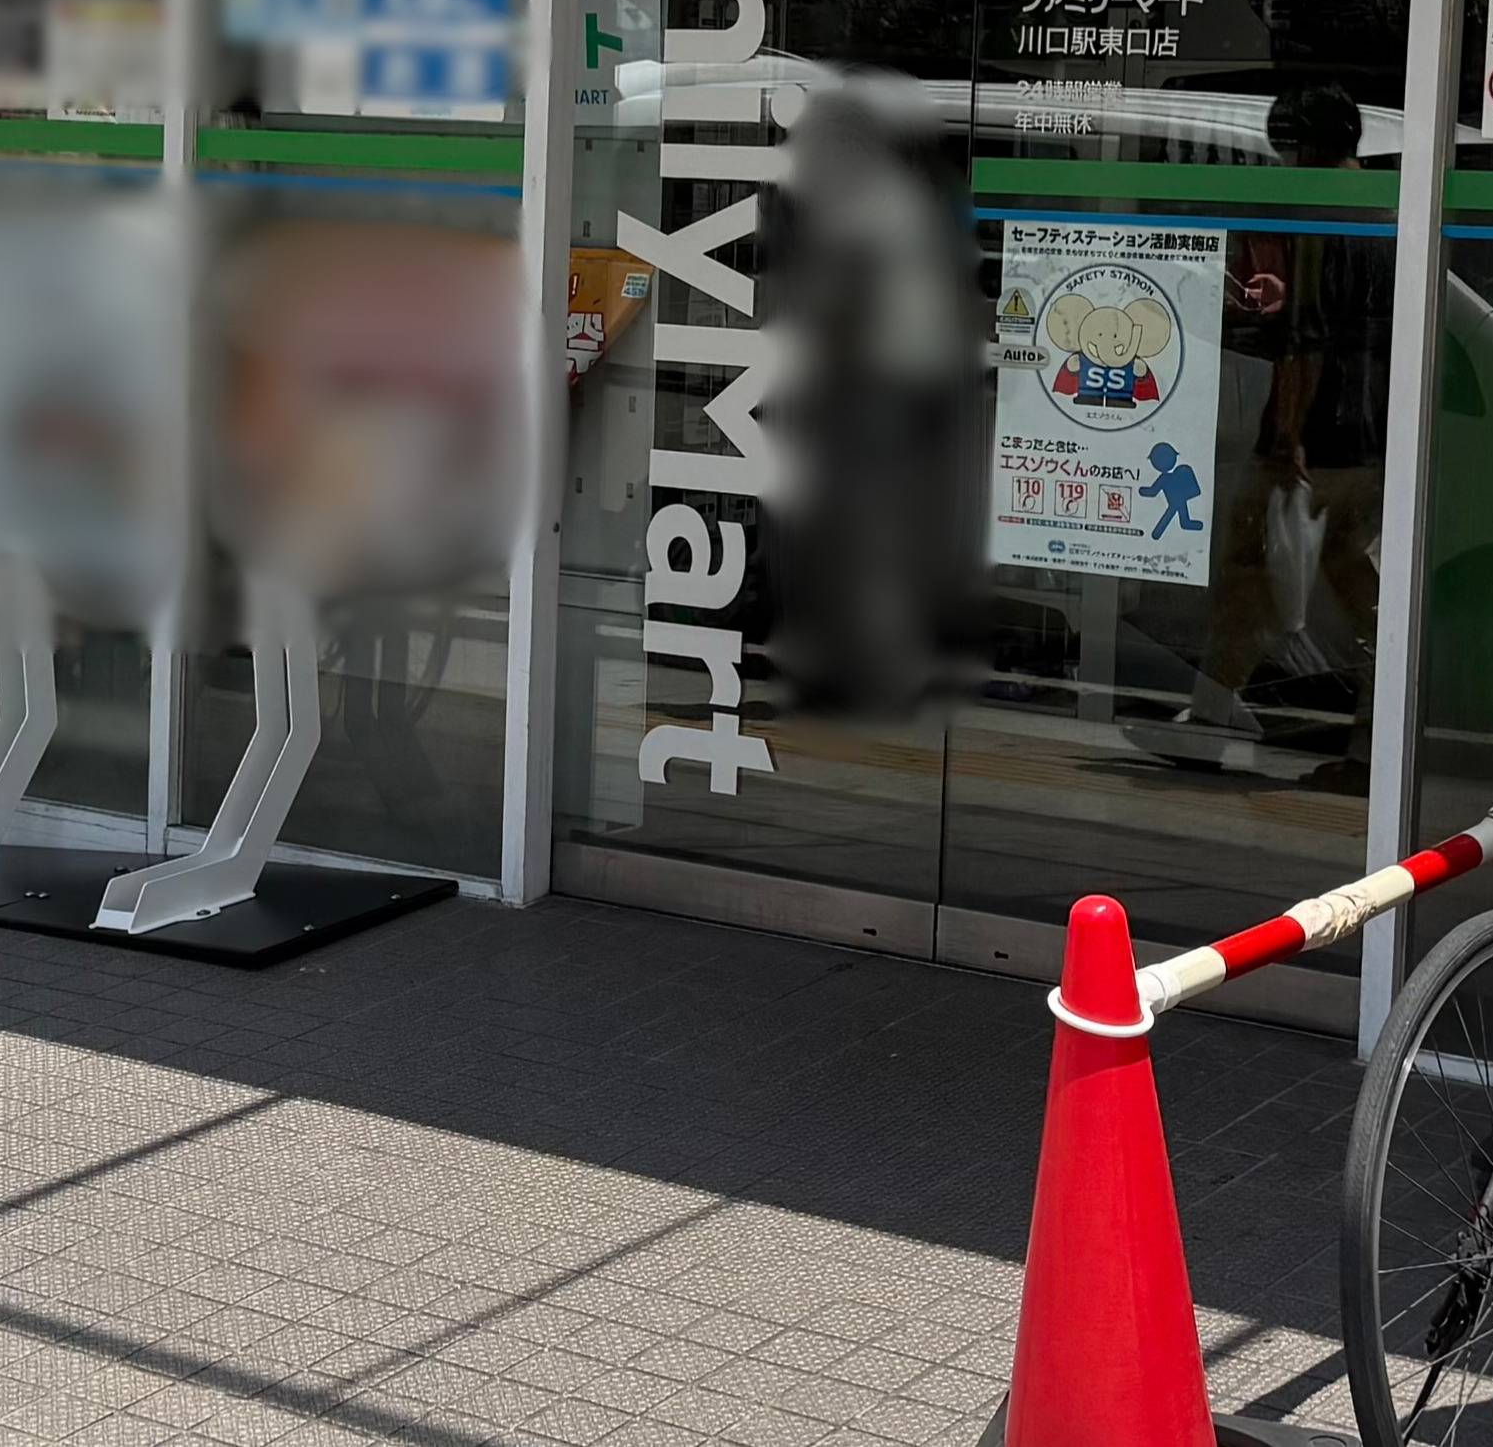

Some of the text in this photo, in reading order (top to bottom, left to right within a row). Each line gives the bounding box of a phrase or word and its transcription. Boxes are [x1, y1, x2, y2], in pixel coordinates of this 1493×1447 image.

[1018, 25, 1181, 57] 川口駅東口店
[575, 89, 609, 105] ART
[1014, 111, 1093, 135] 年中無休
[1011, 225, 1220, 253] セーフティステーション活動実施店
[1064, 269, 1156, 297] SAFETY STATION
[1003, 349, 1037, 362] Auto
[1085, 366, 1127, 390] SS
[1014, 478, 1086, 500] 110 119
